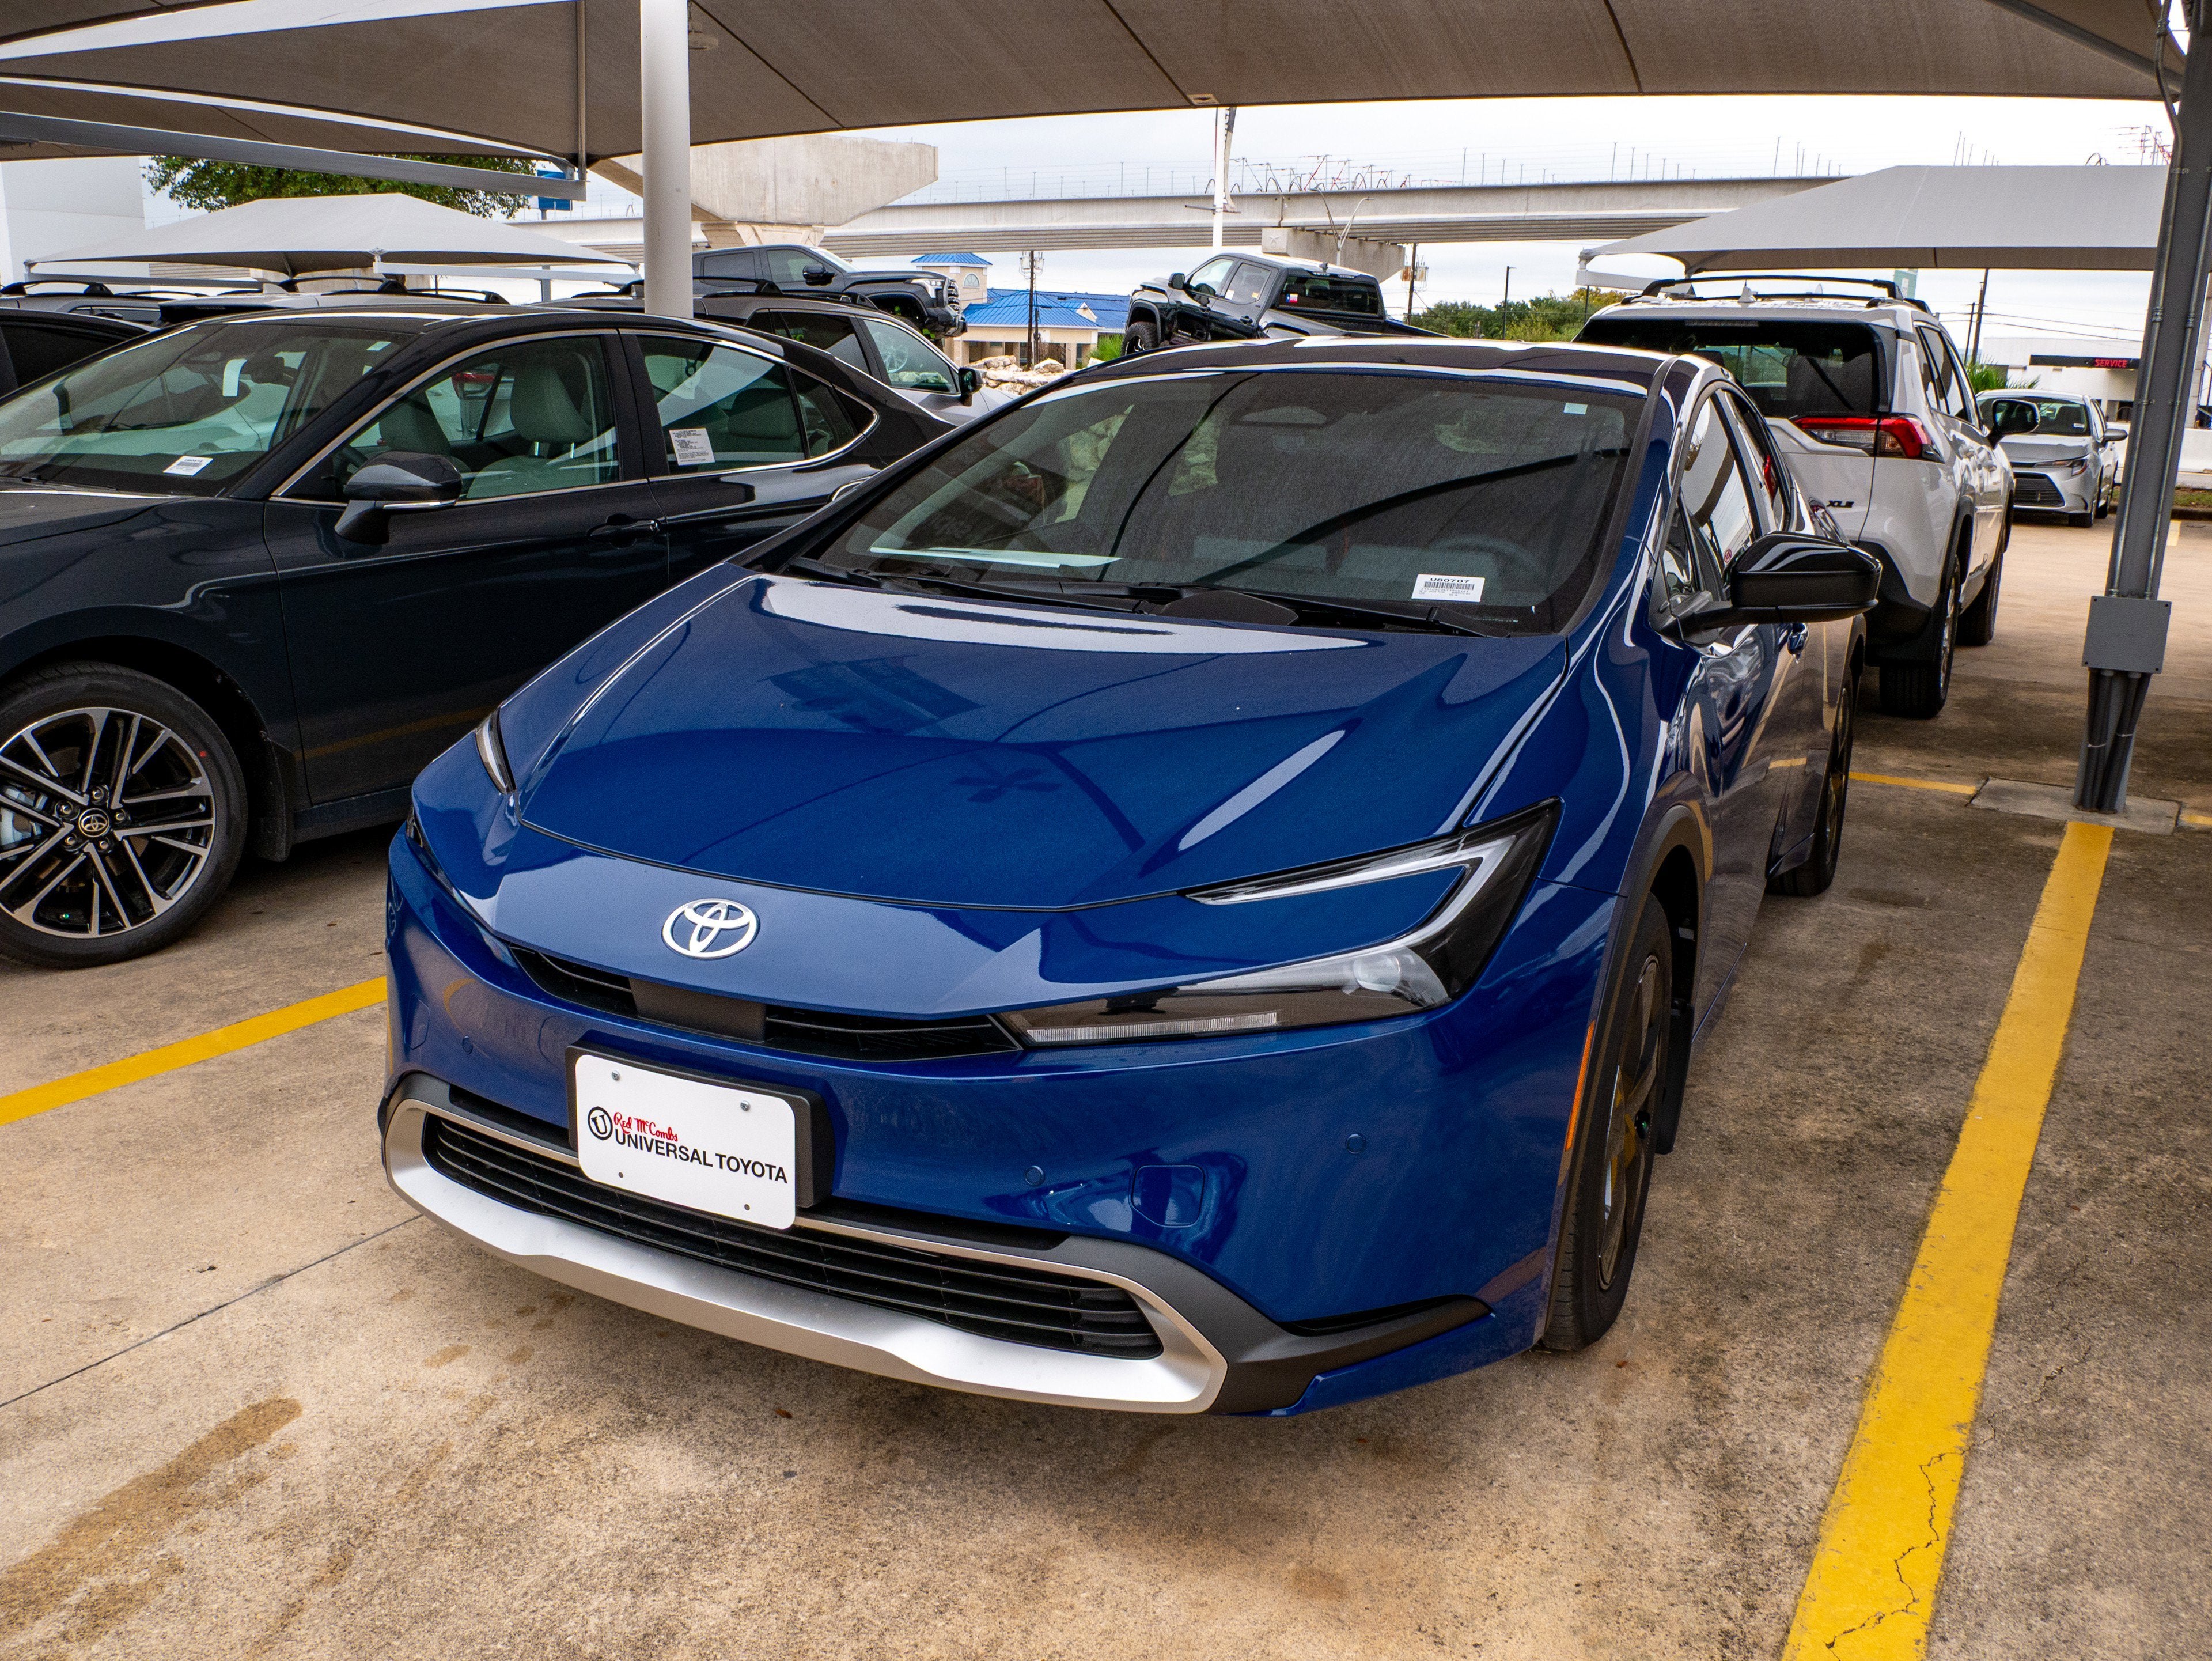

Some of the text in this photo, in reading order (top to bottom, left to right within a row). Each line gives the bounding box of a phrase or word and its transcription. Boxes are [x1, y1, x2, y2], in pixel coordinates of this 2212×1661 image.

[2094, 358, 2128, 368] SERVICE
[613, 1111, 678, 1142] Red McCombs
[615, 1129, 788, 1184] UNIVERSAL TOYOTA
